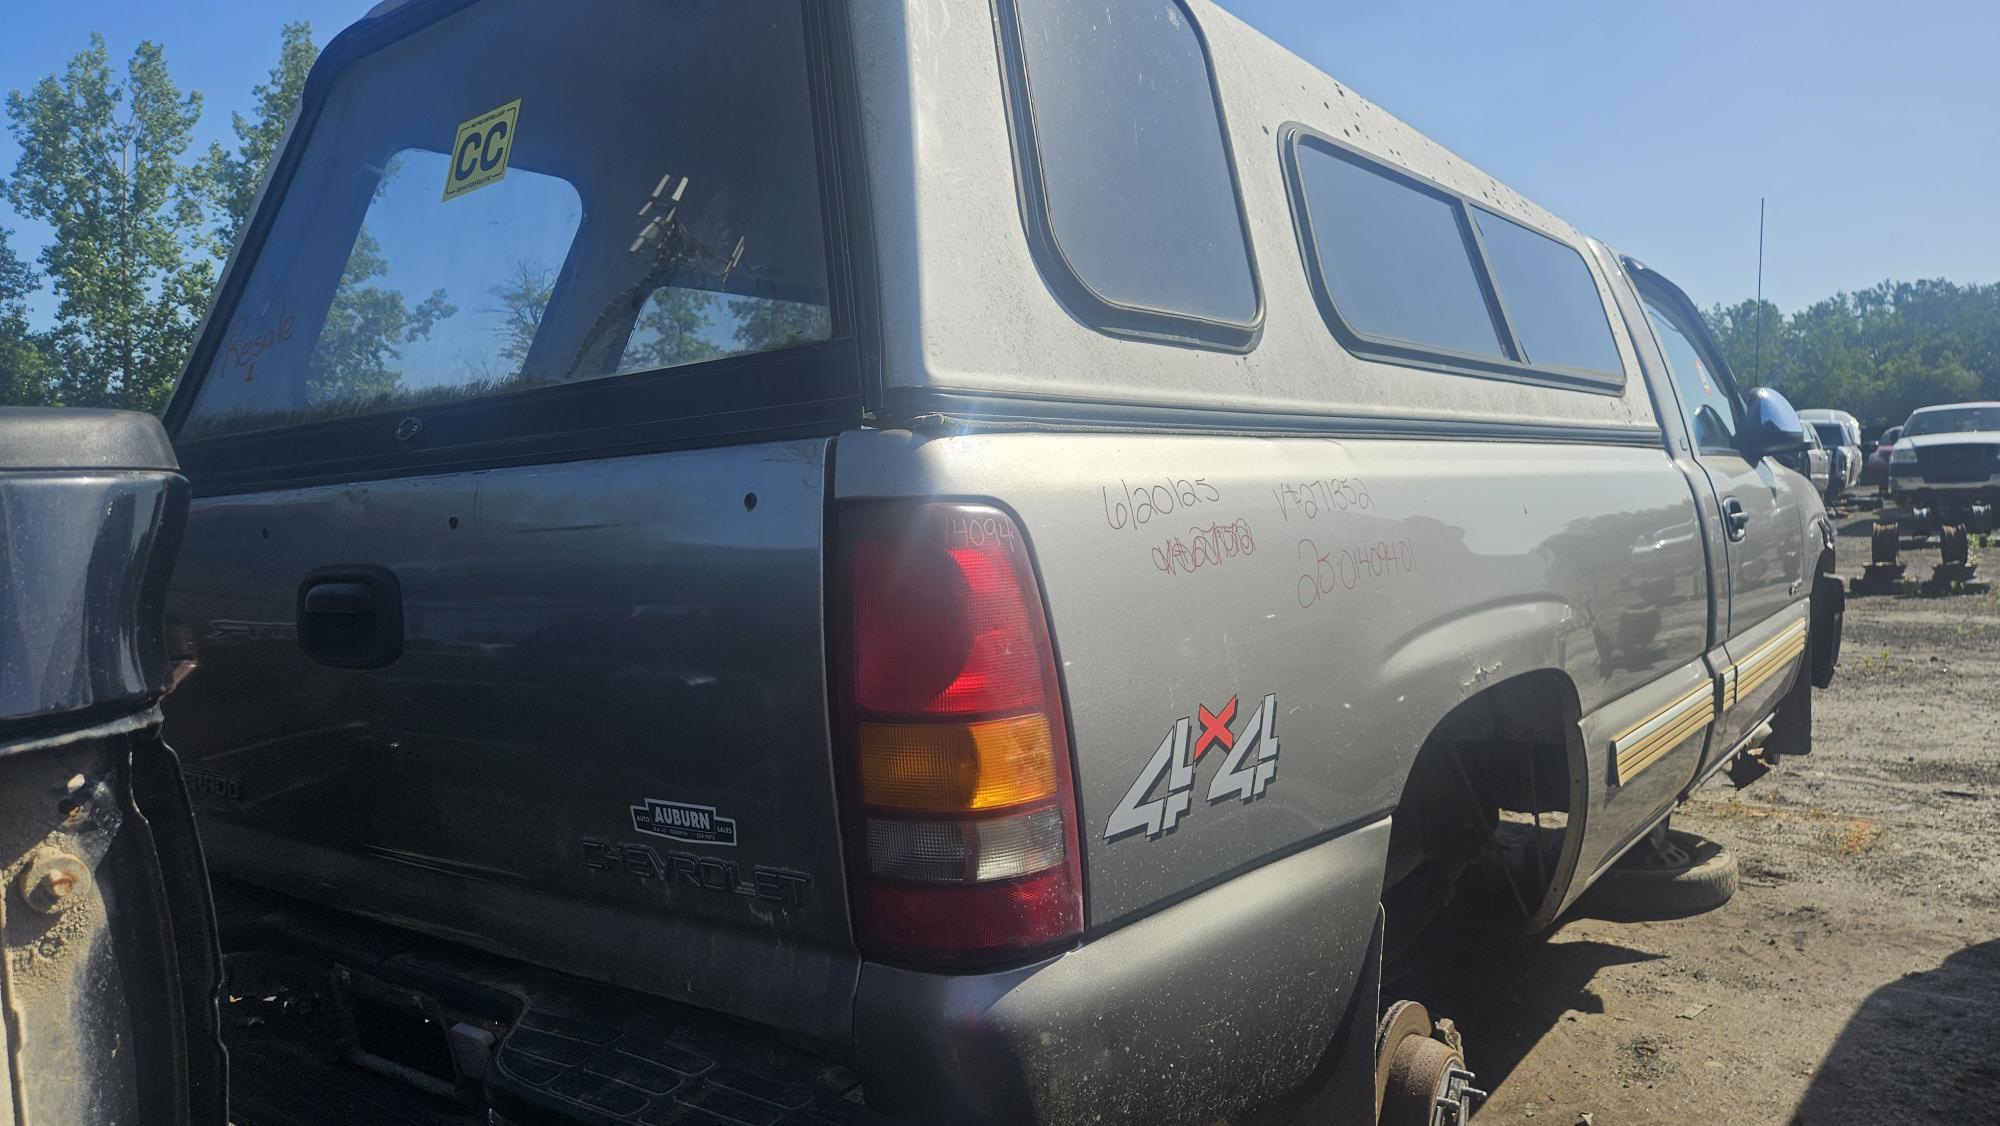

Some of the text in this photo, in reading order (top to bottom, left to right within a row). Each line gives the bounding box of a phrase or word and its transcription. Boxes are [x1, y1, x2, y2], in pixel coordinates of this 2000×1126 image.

[455, 121, 507, 181] CC
[219, 297, 296, 380] Resale
[636, 815, 650, 823] AUTO
[654, 806, 711, 830] AUBURN
[716, 826, 733, 835] SALES
[580, 836, 815, 907] CHEVROLET
